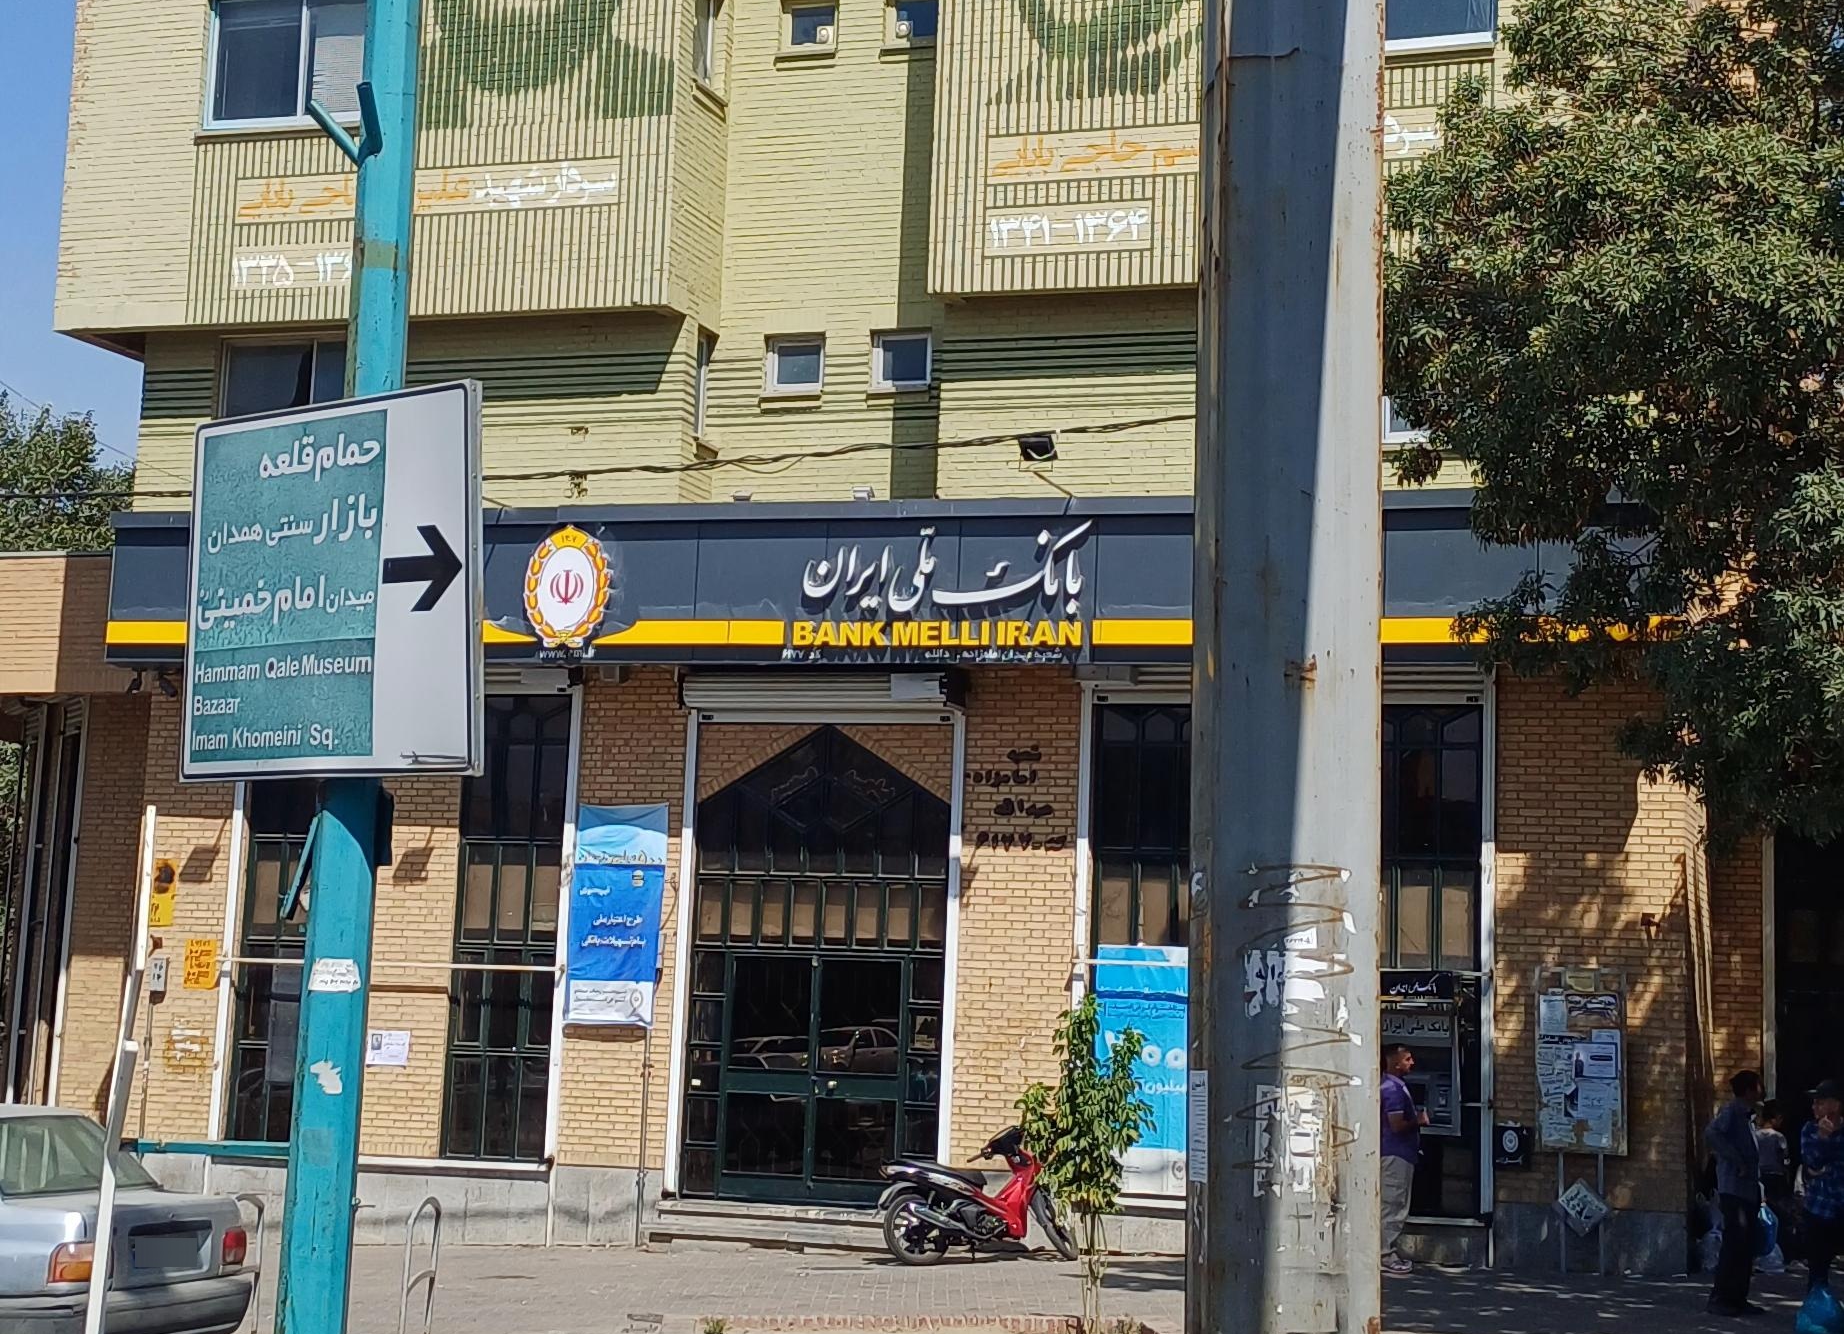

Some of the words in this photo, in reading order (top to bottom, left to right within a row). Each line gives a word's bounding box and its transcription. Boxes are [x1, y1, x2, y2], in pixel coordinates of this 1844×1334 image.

[259, 434, 315, 479] قلعه
[314, 433, 381, 482] حمام
[207, 521, 263, 554] همدان
[265, 514, 314, 547] سنتی
[312, 492, 378, 545] بازار
[802, 544, 893, 609] ایران
[887, 525, 938, 613] ملی
[197, 578, 273, 630] خمینی
[272, 574, 325, 625] امام
[325, 587, 375, 614] میدان
[792, 620, 888, 647] BANK
[891, 620, 990, 647] MELLI
[997, 620, 1082, 647] IRAN
[194, 663, 260, 685] Hammam
[265, 655, 300, 680] Qale
[300, 653, 372, 677] Museum
[193, 695, 241, 716] Bazaar
[191, 730, 228, 751] Imam
[231, 724, 303, 750] Khomeini
[309, 723, 338, 751] Sq.
